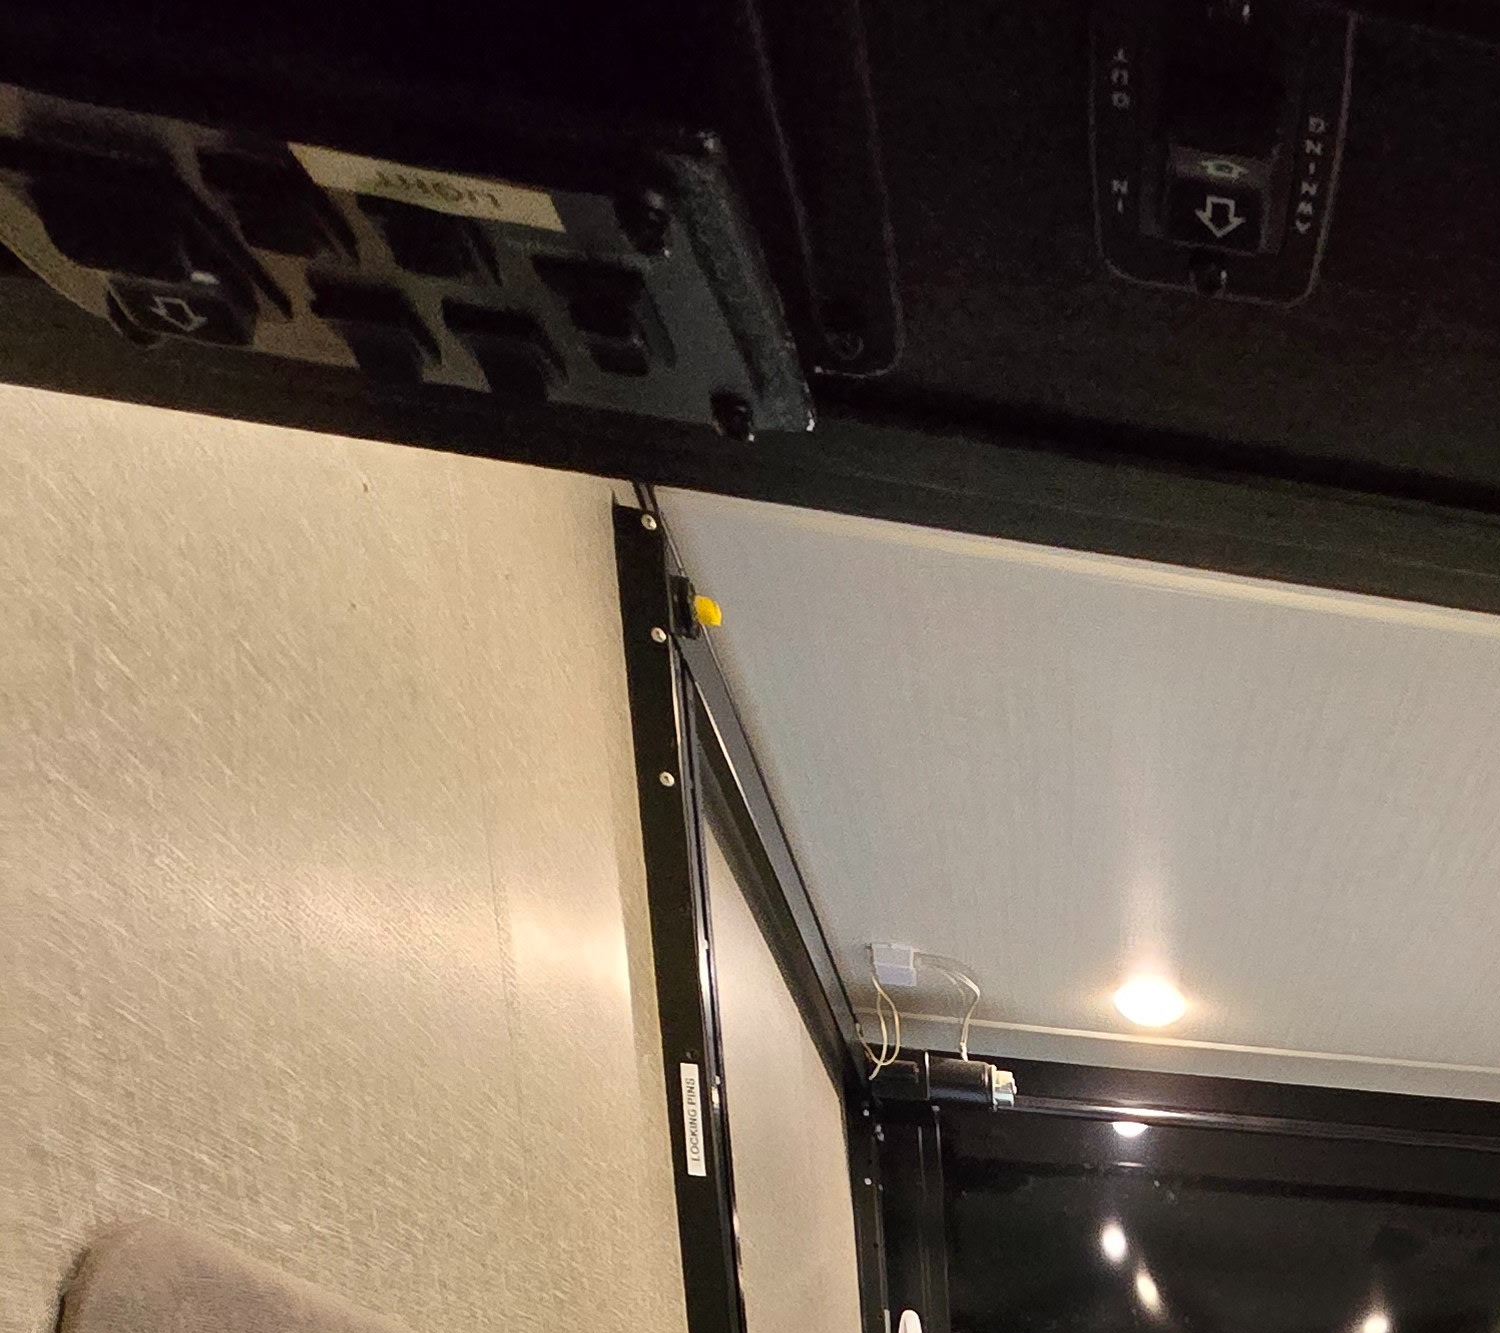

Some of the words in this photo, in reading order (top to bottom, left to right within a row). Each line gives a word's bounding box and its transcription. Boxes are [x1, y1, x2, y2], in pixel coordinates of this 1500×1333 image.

[1111, 48, 1131, 109] OUT
[1111, 178, 1129, 214] IN
[1295, 114, 1328, 234] AWNING
[686, 1077, 697, 1106] PINS
[688, 1109, 700, 1162] LOCKING
